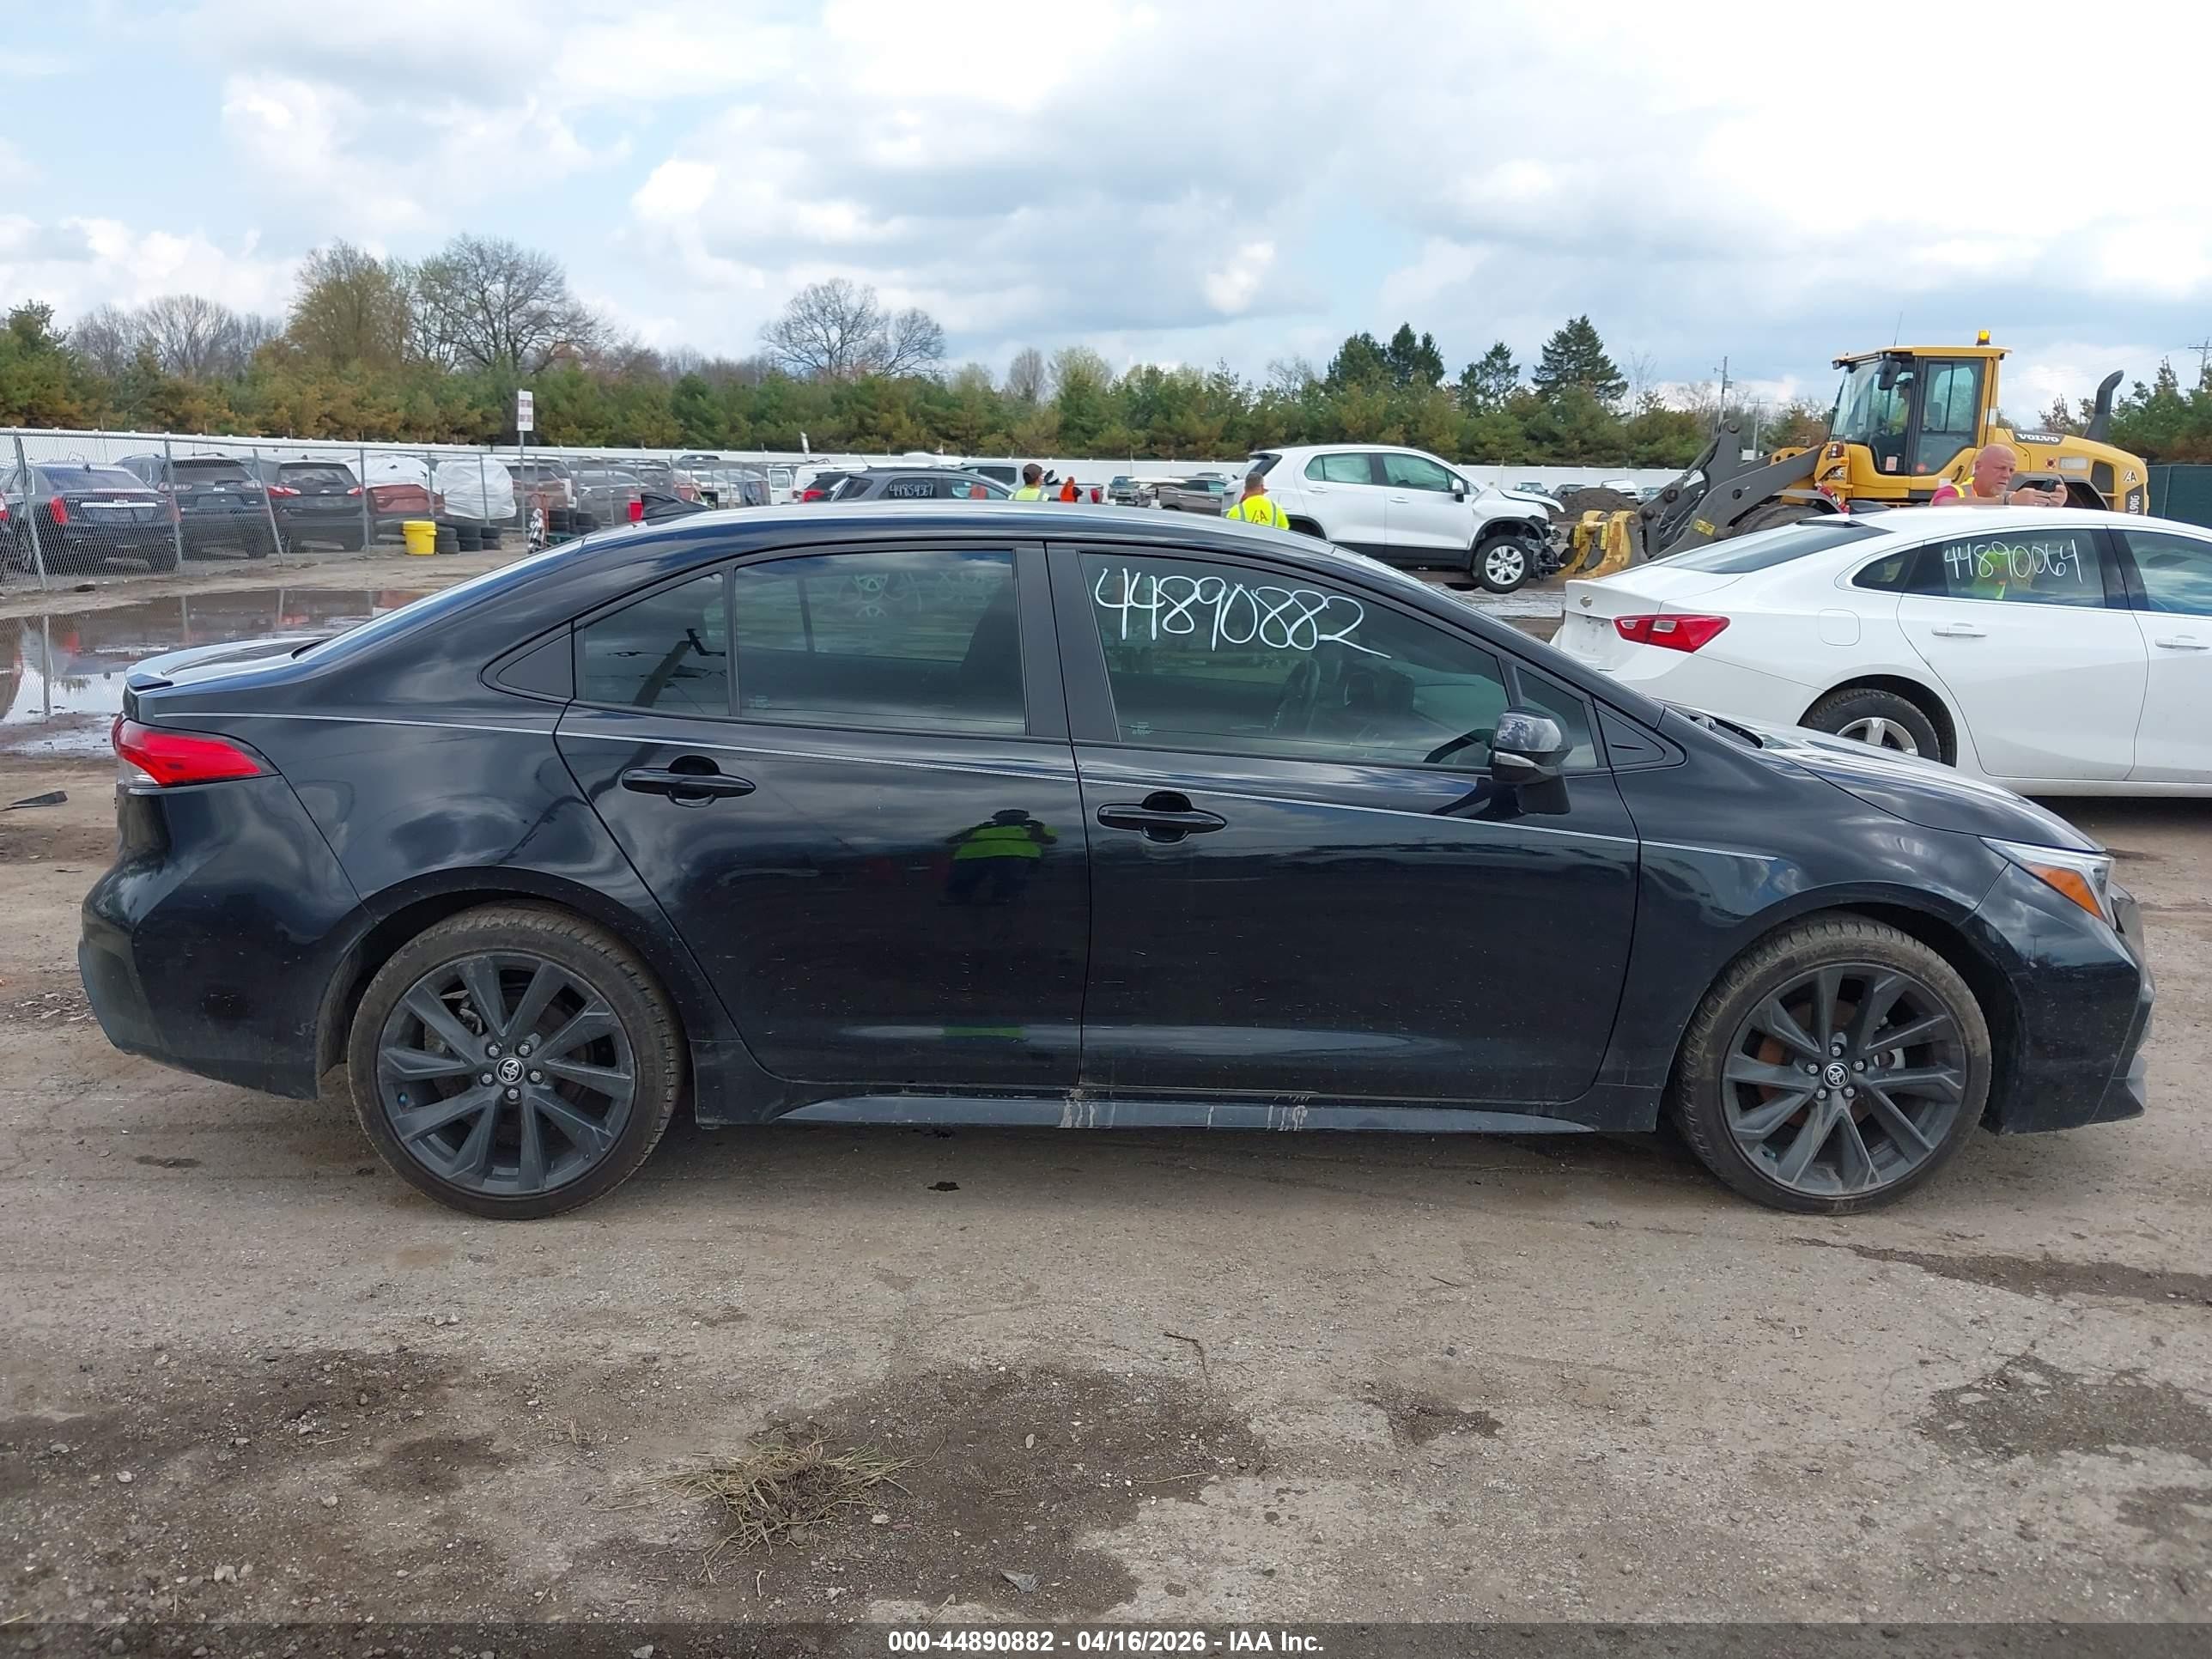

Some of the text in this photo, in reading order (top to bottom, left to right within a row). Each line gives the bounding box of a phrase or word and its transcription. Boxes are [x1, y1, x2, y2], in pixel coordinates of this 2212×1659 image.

[2016, 433, 2060, 443] VOLVO
[2129, 495, 2141, 514] L90G
[1944, 538, 2083, 585] 44890064
[1094, 567, 1393, 659] 44890882
